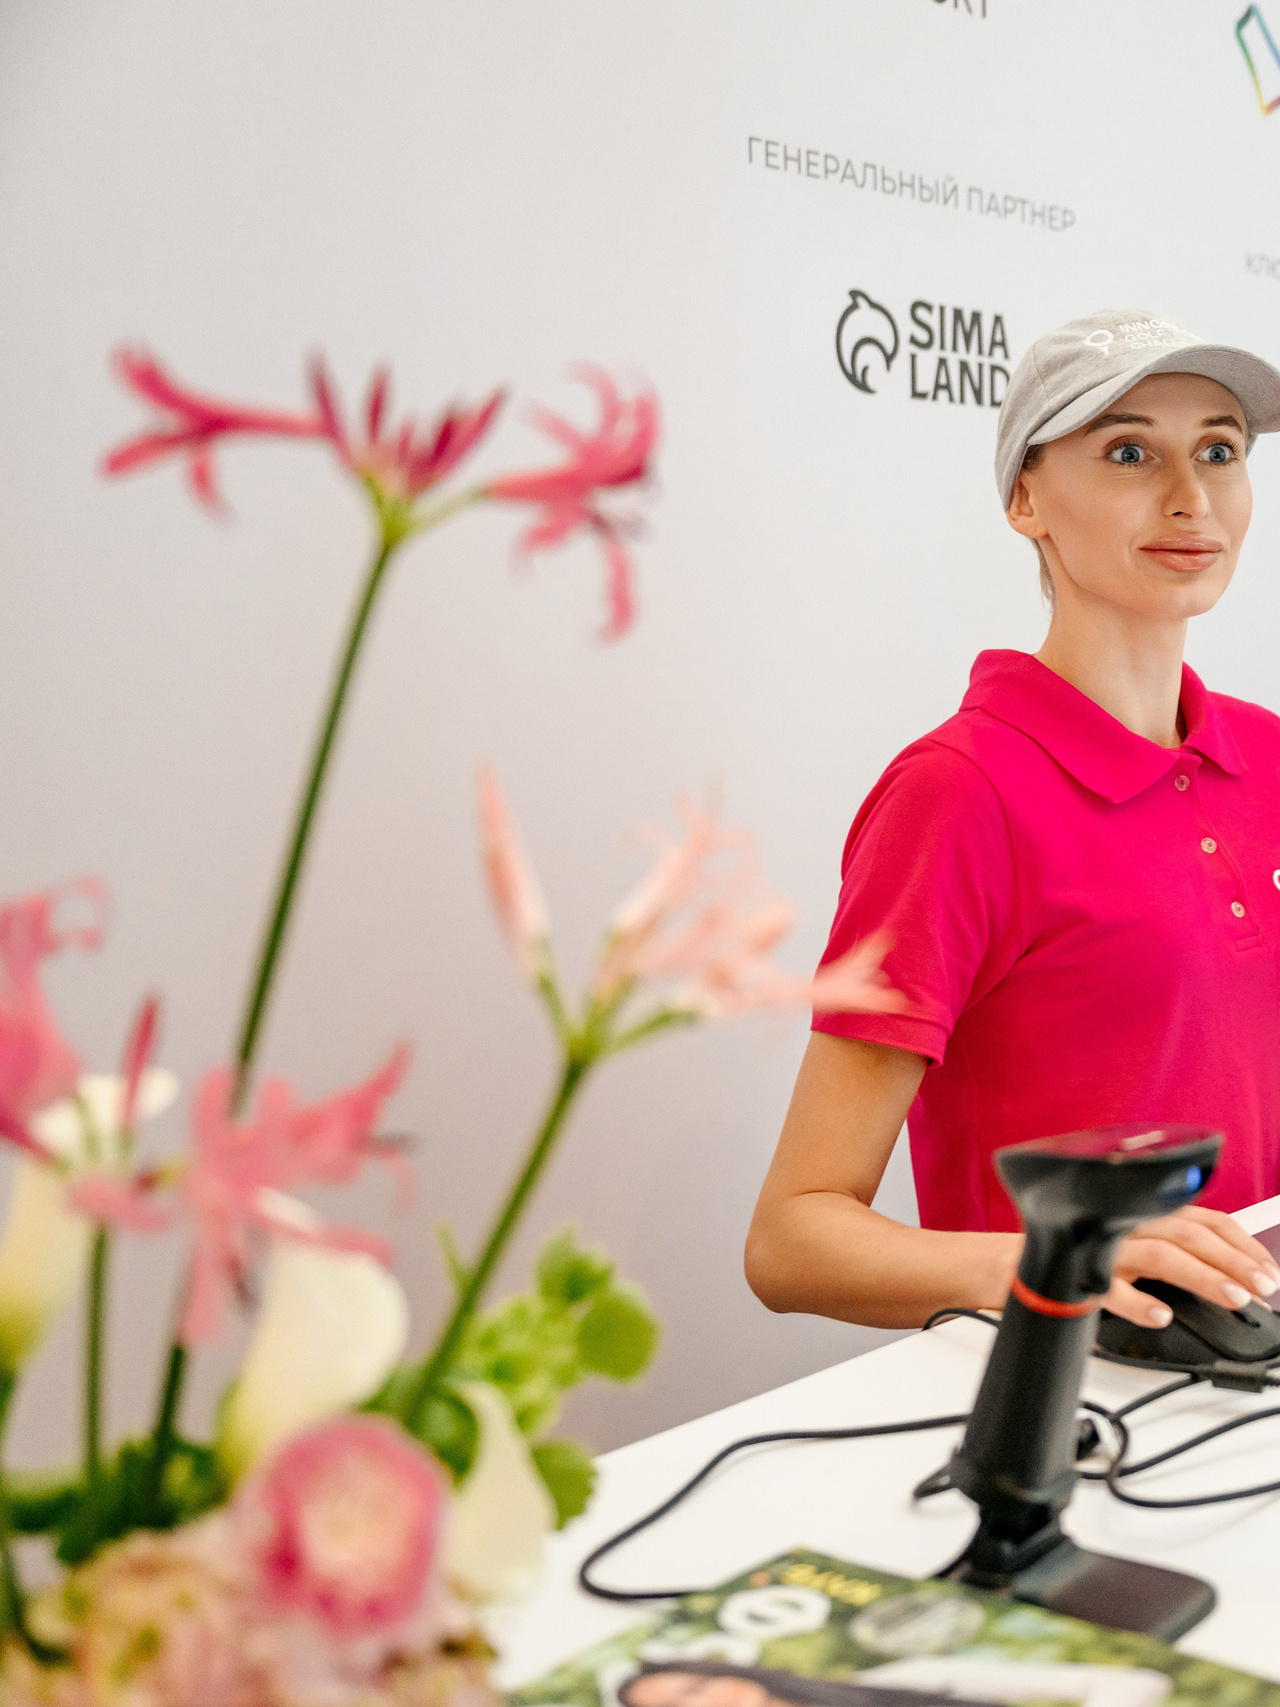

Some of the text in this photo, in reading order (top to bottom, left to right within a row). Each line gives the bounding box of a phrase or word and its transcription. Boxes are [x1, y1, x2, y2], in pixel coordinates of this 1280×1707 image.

[748, 135, 1076, 232] ГЕНЕРАЛЬНЫЙ ПАРТНЕР
[909, 300, 1010, 360] SIMA
[1124, 329, 1165, 342] GOLF
[910, 353, 1011, 408] LAND
